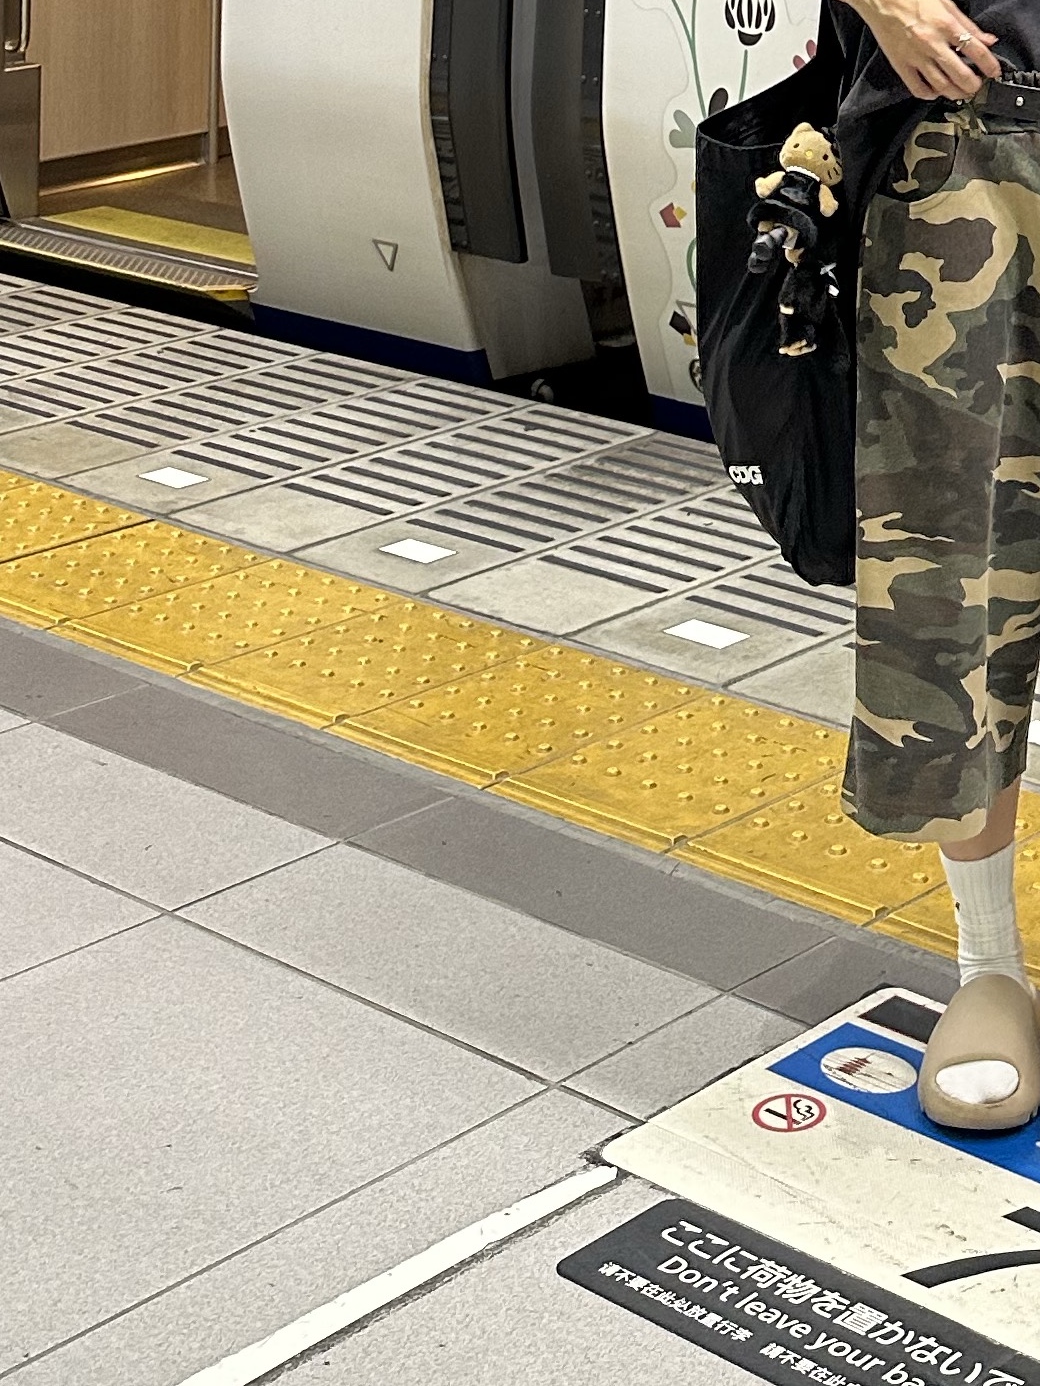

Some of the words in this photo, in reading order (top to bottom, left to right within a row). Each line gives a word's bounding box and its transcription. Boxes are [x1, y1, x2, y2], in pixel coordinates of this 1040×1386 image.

[657, 1254, 740, 1302] Don't
[734, 1291, 813, 1338] leave
[803, 1332, 886, 1371] your
